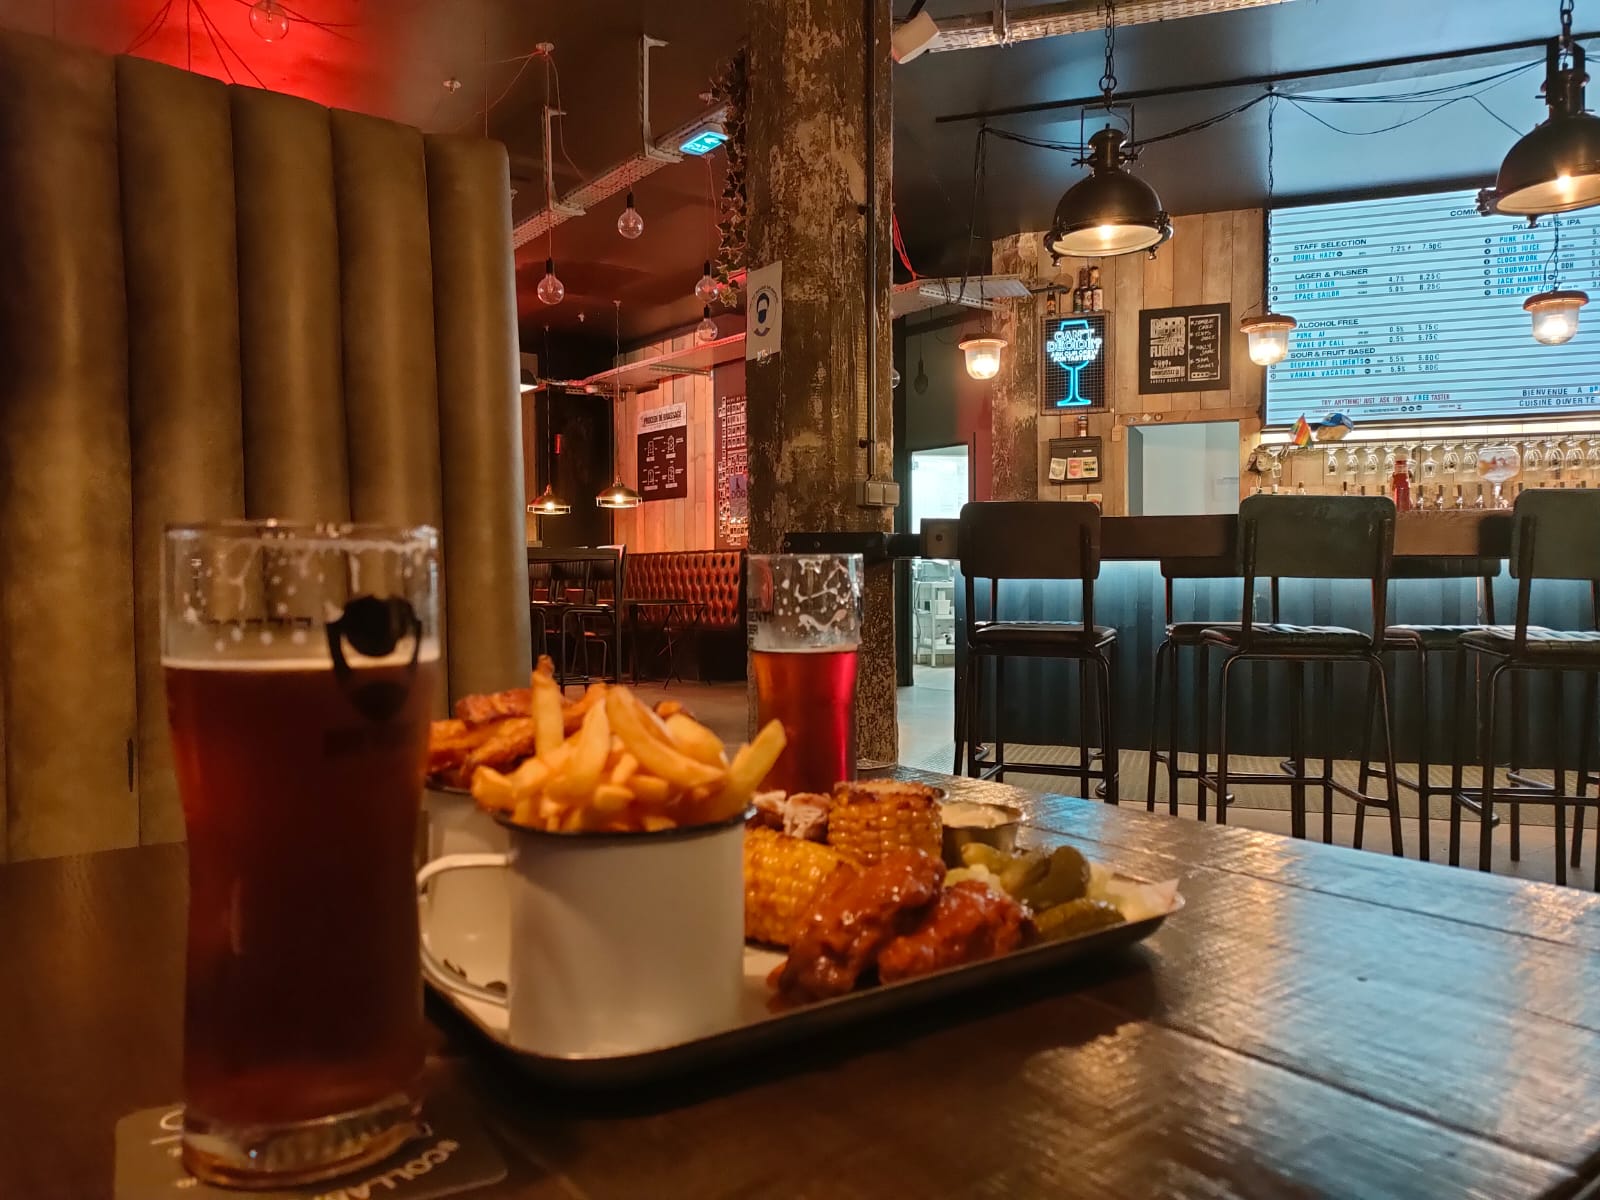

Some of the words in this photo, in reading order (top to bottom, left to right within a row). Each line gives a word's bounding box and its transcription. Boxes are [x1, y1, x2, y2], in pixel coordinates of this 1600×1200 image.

[1450, 209, 1478, 217] COMM
[1567, 218, 1581, 226] IPA
[1499, 235, 1517, 243] PUNK
[1294, 243, 1318, 251] STAFF
[1320, 239, 1367, 249] SELECTION
[1319, 251, 1336, 259] HAZY
[1295, 272, 1322, 280] LAGER
[1333, 268, 1369, 277] PILSNER
[1497, 264, 1543, 274] CLOUDWATER
[1295, 282, 1311, 290] LOST
[1315, 280, 1335, 289] LAGER
[1497, 277, 1514, 285] JACK
[1294, 292, 1315, 300] SPACE
[1317, 290, 1340, 298] SAILOR
[1497, 287, 1514, 295] DEAD
[1517, 285, 1534, 294] PONY
[1298, 320, 1336, 329] ALCOHOL
[1337, 318, 1359, 326] FREE
[1296, 331, 1312, 339] PUNK
[1296, 341, 1315, 349] WAKE
[1318, 340, 1327, 348] UP
[1329, 339, 1345, 347] CALL
[1150, 344, 1186, 357] FLIGHTS
[1290, 350, 1314, 359] SOUR
[1321, 349, 1345, 357] FRUIT
[1348, 347, 1376, 355] BASED
[1321, 368, 1356, 377] VACATION
[1522, 388, 1568, 397] BIENVENUE
[1321, 398, 1331, 406] TRY
[1363, 396, 1375, 404] JUST
[1392, 395, 1403, 403] FOR
[1431, 393, 1450, 401] TASTER
[1519, 398, 1553, 407] CUISINE
[1555, 396, 1596, 405] OUVERTE
